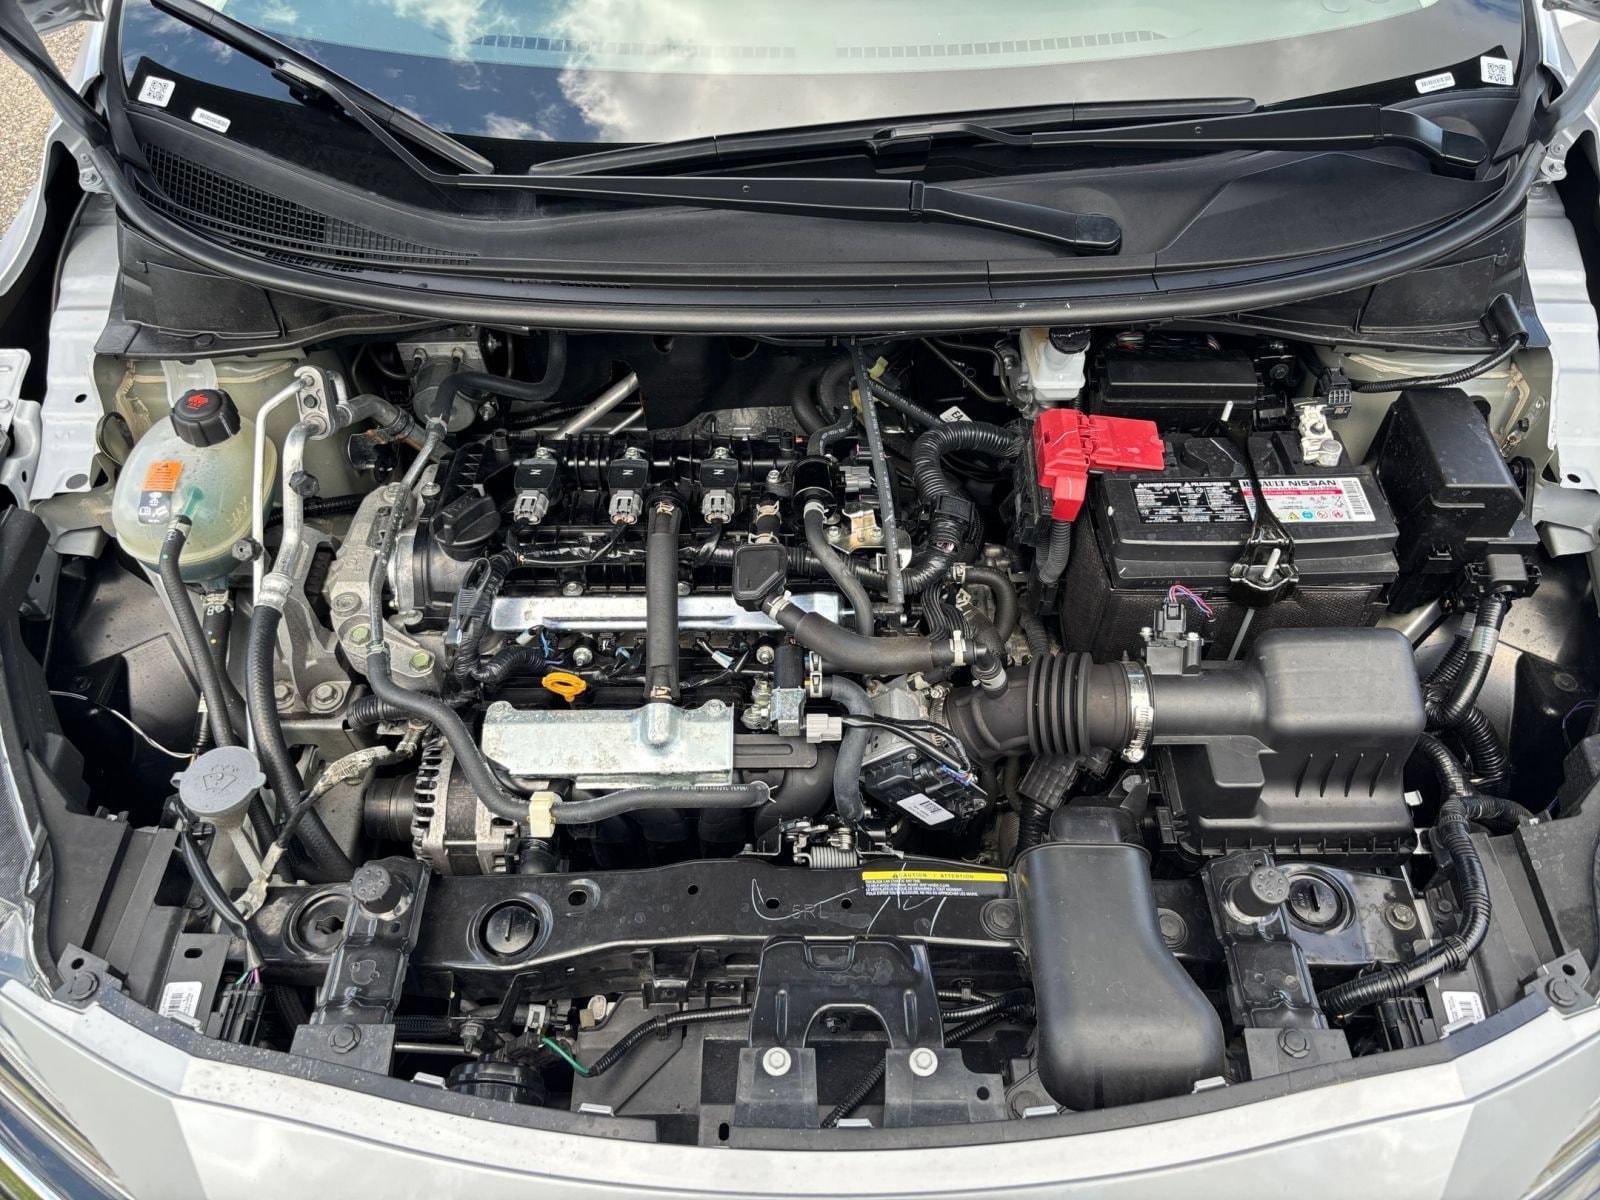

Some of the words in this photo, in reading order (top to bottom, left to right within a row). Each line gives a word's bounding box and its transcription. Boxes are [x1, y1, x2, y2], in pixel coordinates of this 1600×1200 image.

[1242, 479, 1286, 488] RAULT
[1287, 479, 1337, 487] NISSAN
[792, 903, 829, 920] 5RL
